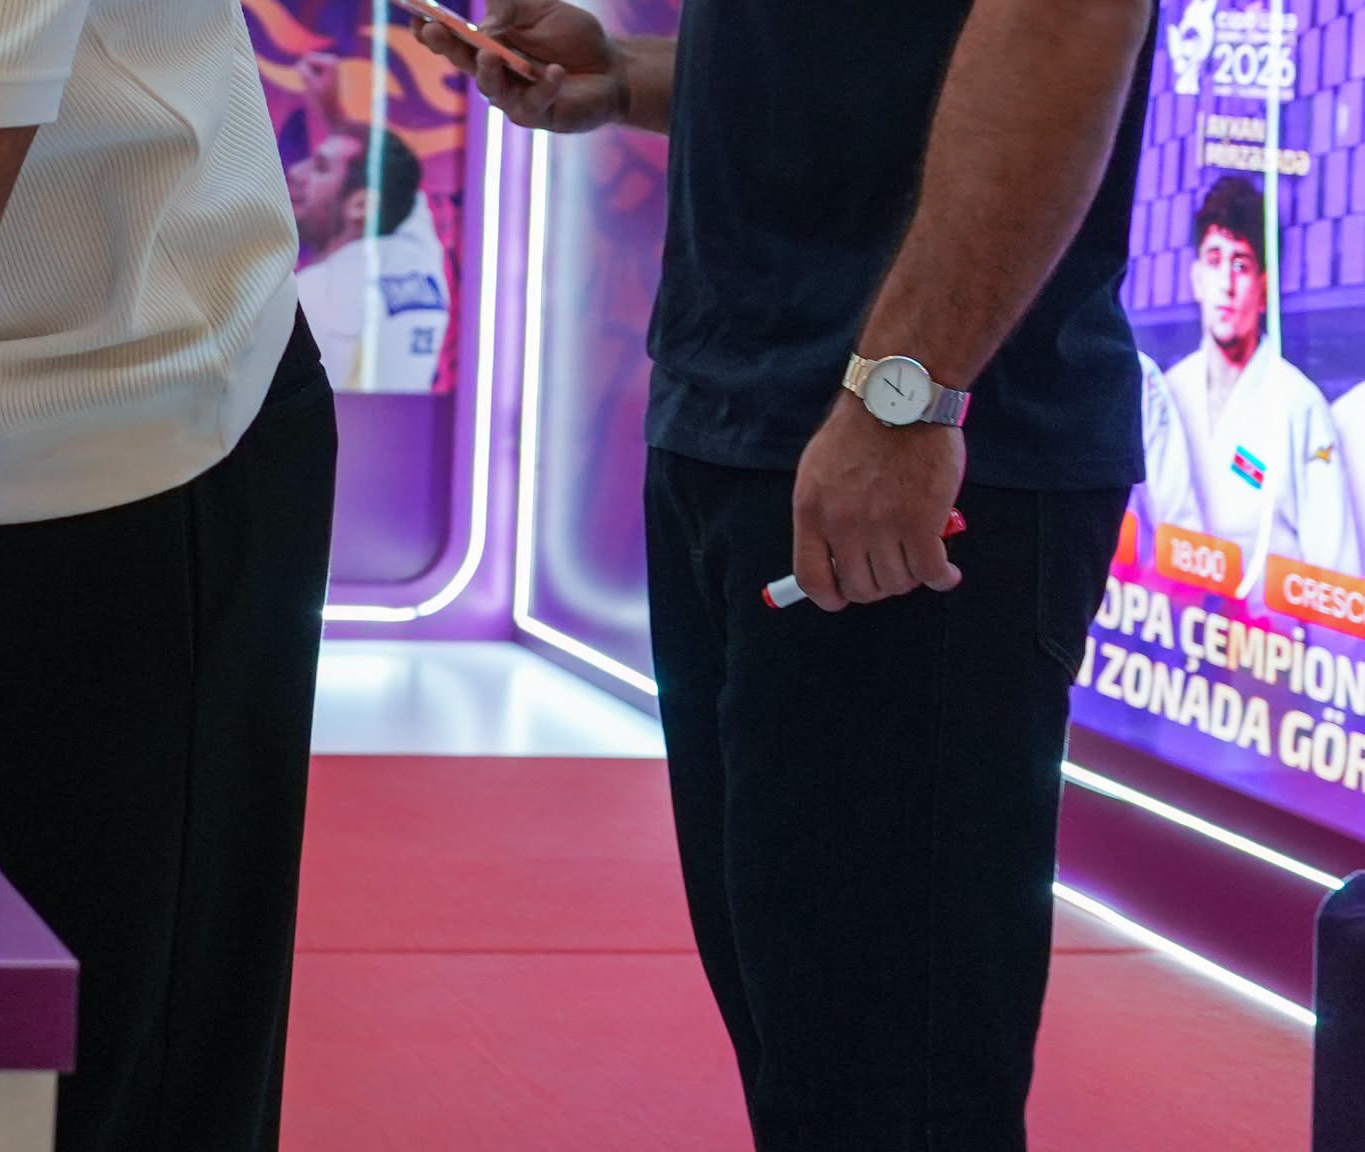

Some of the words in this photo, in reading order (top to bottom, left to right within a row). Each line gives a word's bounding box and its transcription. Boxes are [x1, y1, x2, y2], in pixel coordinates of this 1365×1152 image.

[1213, 43, 1297, 88] 2026
[1171, 537, 1226, 582] 18:00
[1180, 605, 1365, 717] ÇEMPİON
[1096, 642, 1271, 757] ZONADA
[1279, 707, 1365, 796] GÖR
